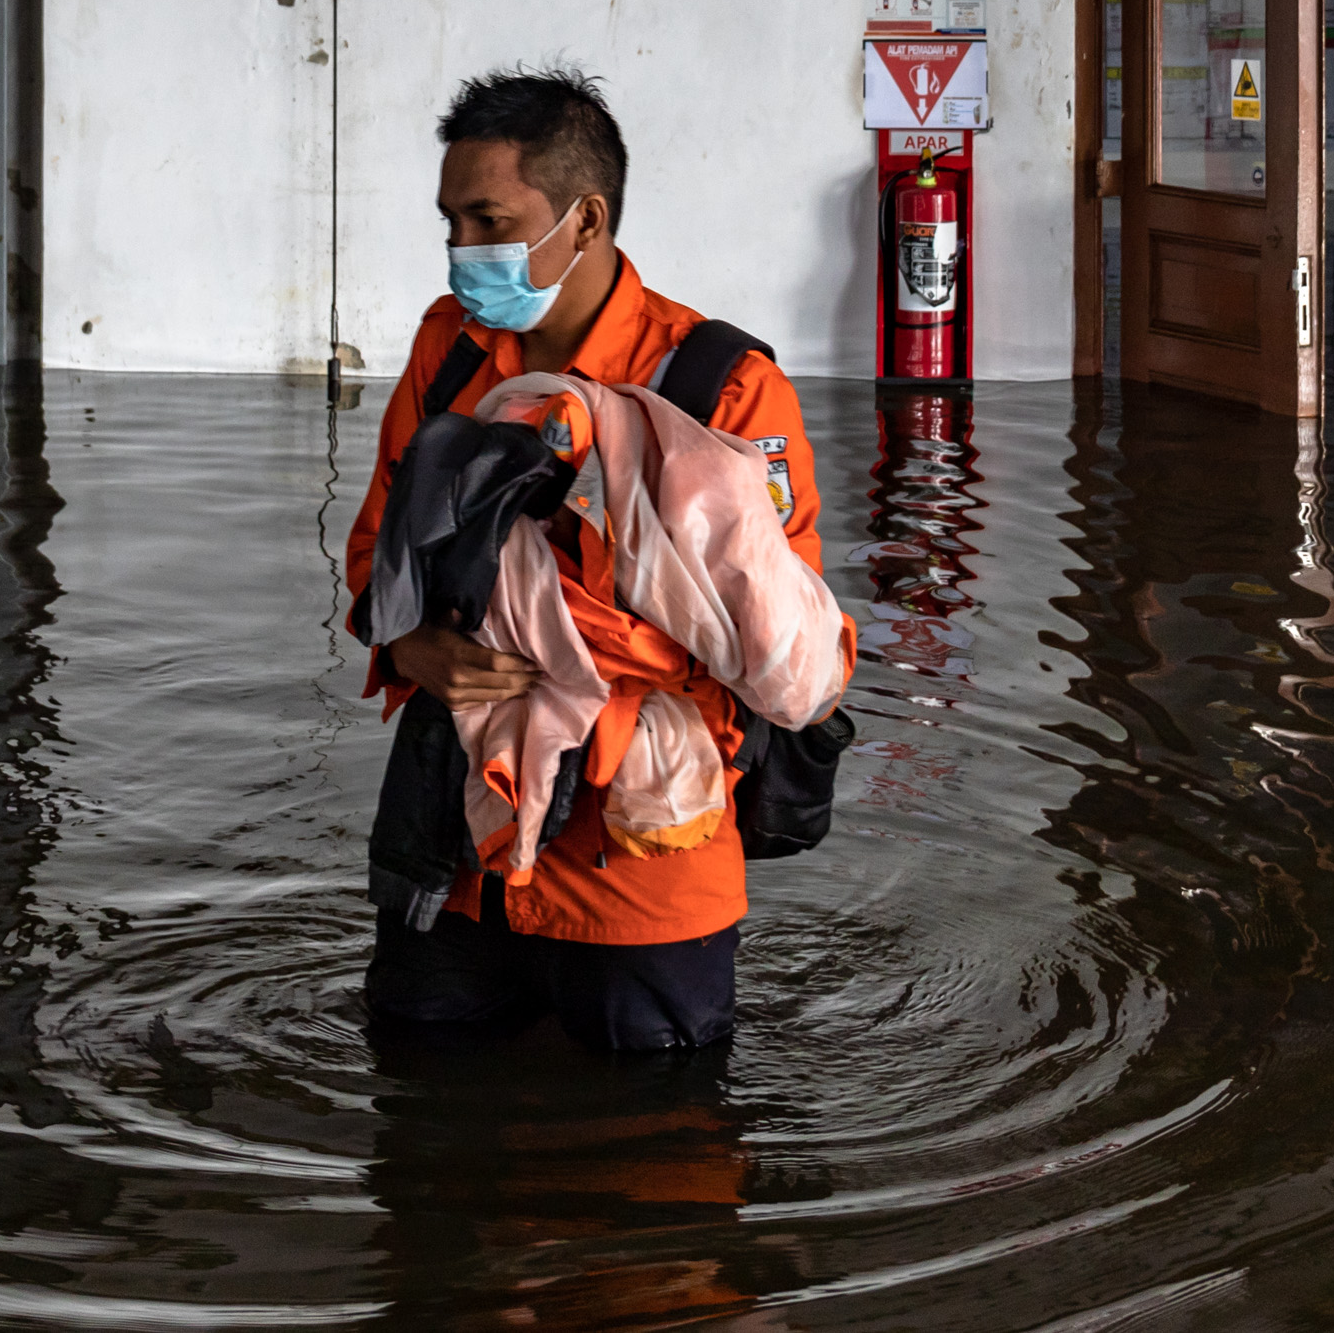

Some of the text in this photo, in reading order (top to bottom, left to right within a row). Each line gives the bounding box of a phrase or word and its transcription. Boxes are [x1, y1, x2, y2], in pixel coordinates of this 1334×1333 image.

[887, 44, 958, 56] ALAT PEMADAM API
[904, 136, 948, 149] APAR
